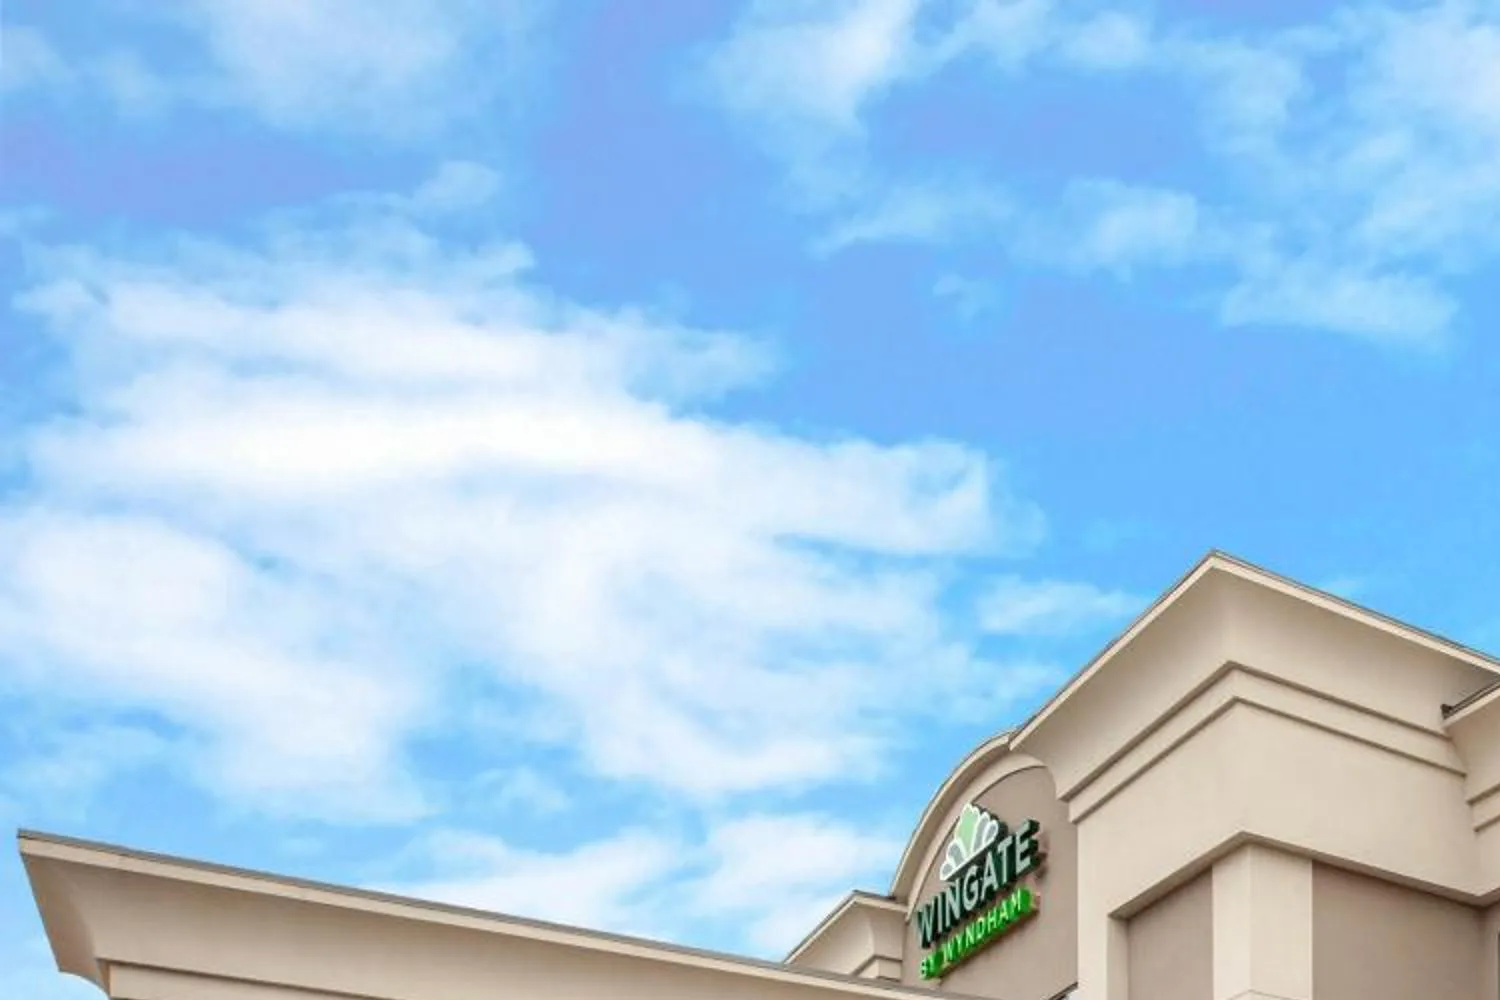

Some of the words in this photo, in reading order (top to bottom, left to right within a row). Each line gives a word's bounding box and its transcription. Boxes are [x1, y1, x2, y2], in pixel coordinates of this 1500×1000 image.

[917, 817, 1040, 948] WINGATE
[919, 953, 937, 979] BY
[941, 884, 1030, 964] WYNDHAM
